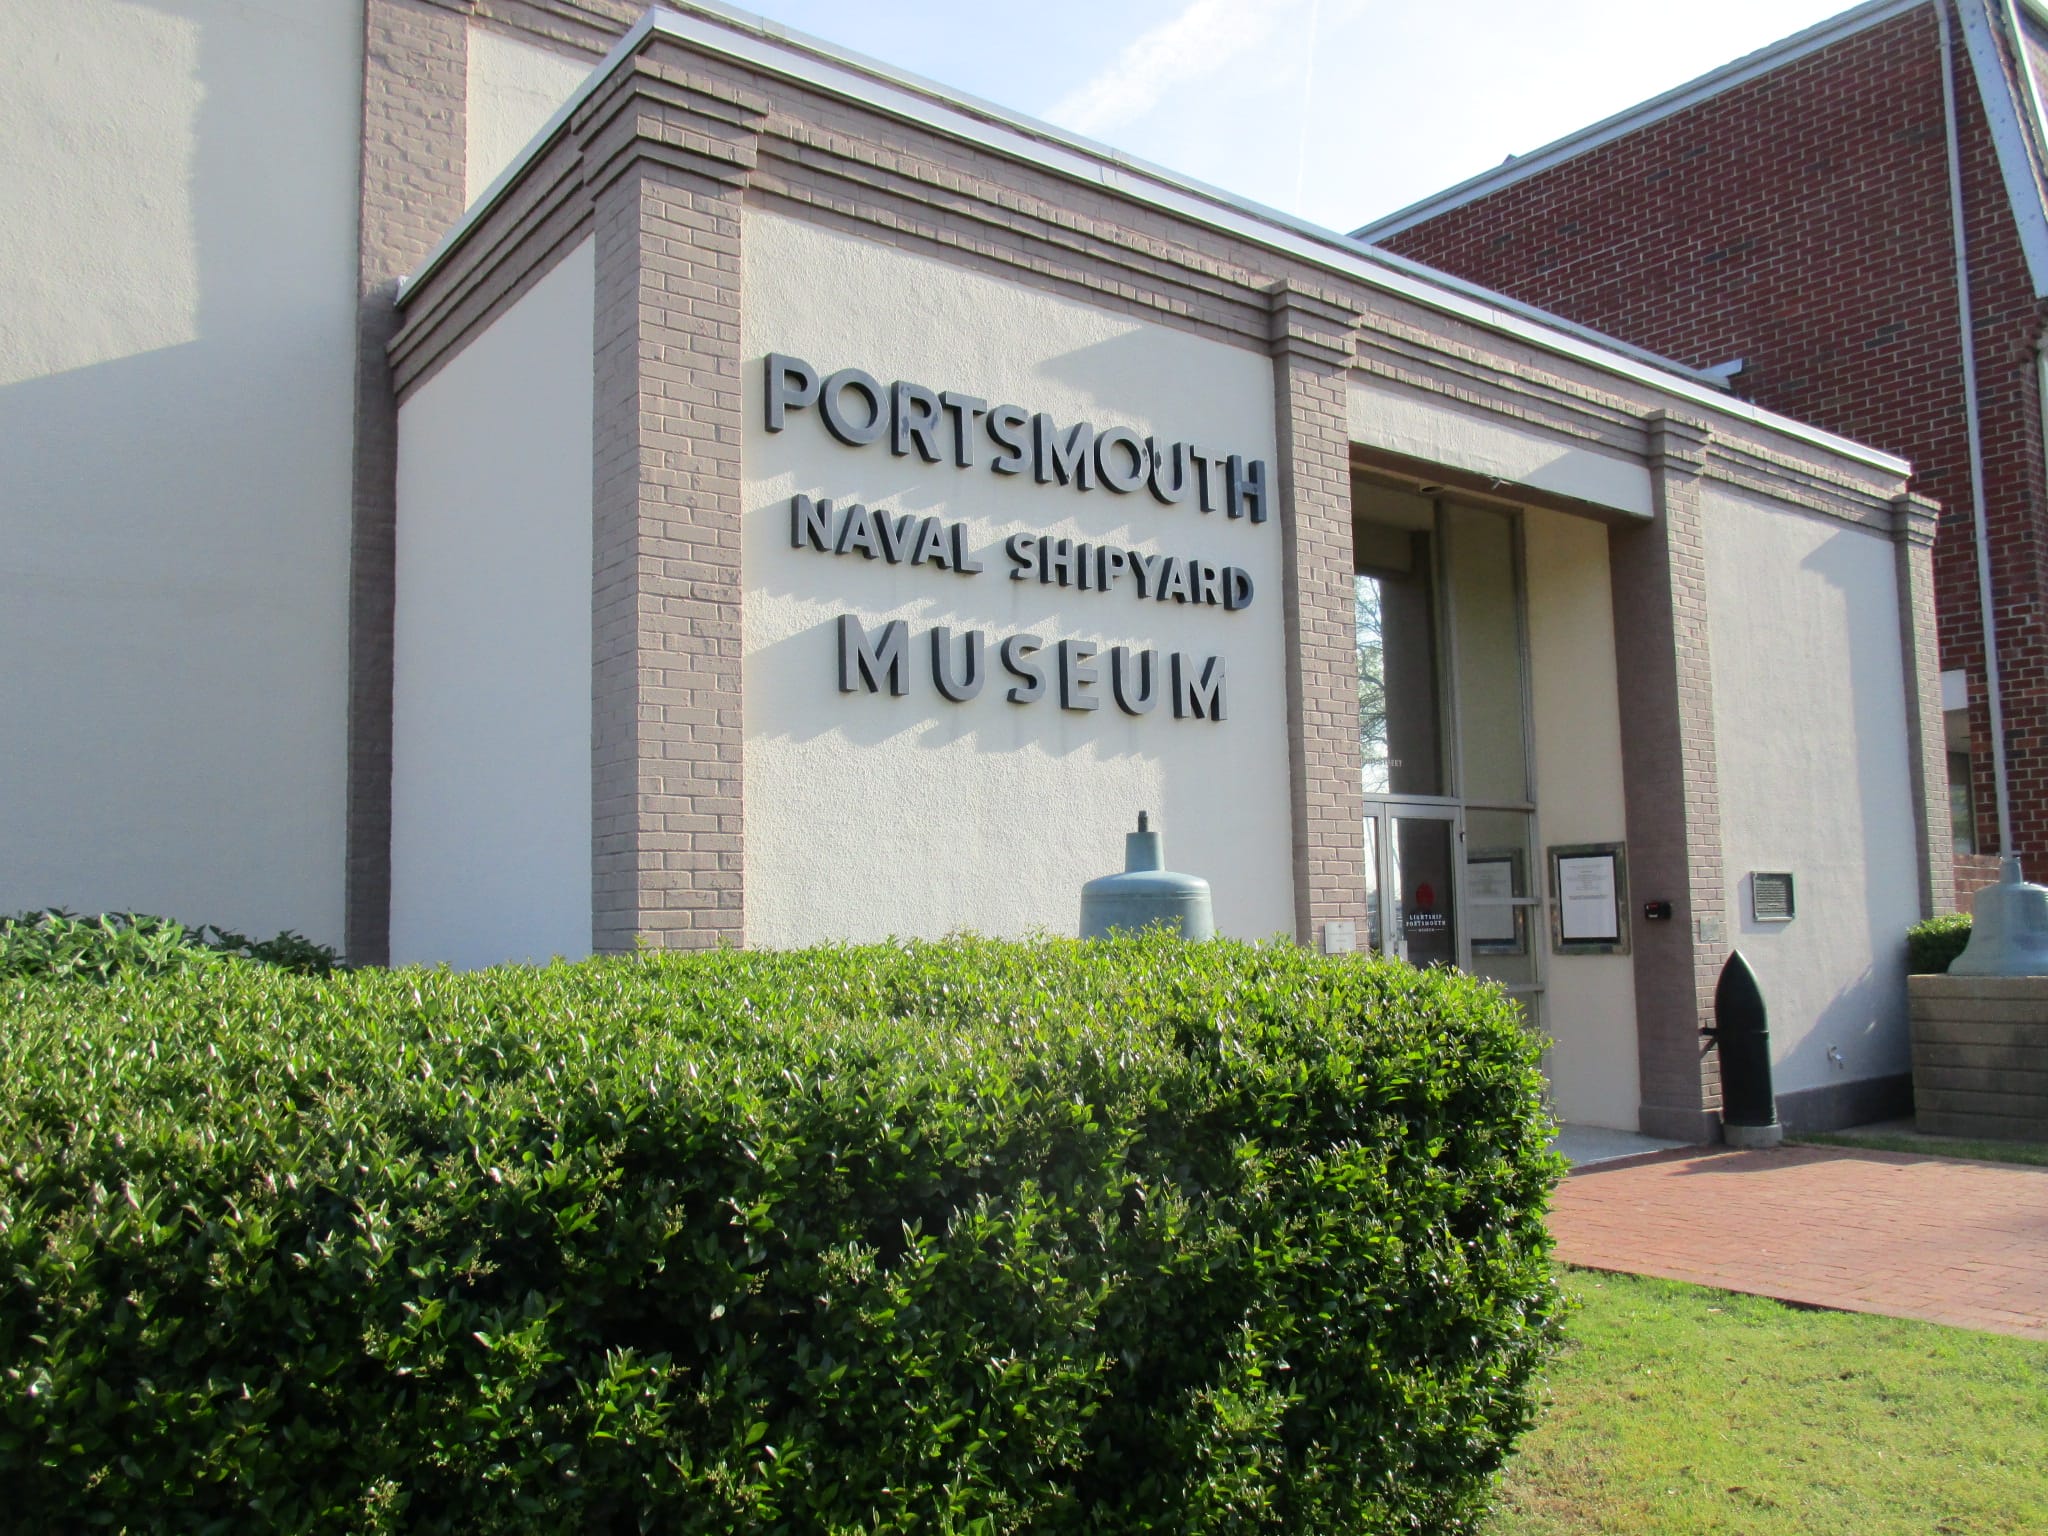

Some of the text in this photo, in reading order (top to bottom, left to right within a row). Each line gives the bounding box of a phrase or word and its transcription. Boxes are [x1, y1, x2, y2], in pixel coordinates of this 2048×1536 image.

[764, 352, 1267, 523] PORTSMOUTH
[791, 493, 1254, 611] NAVAL SHIPYARD
[838, 614, 1227, 722] MUSEUM
